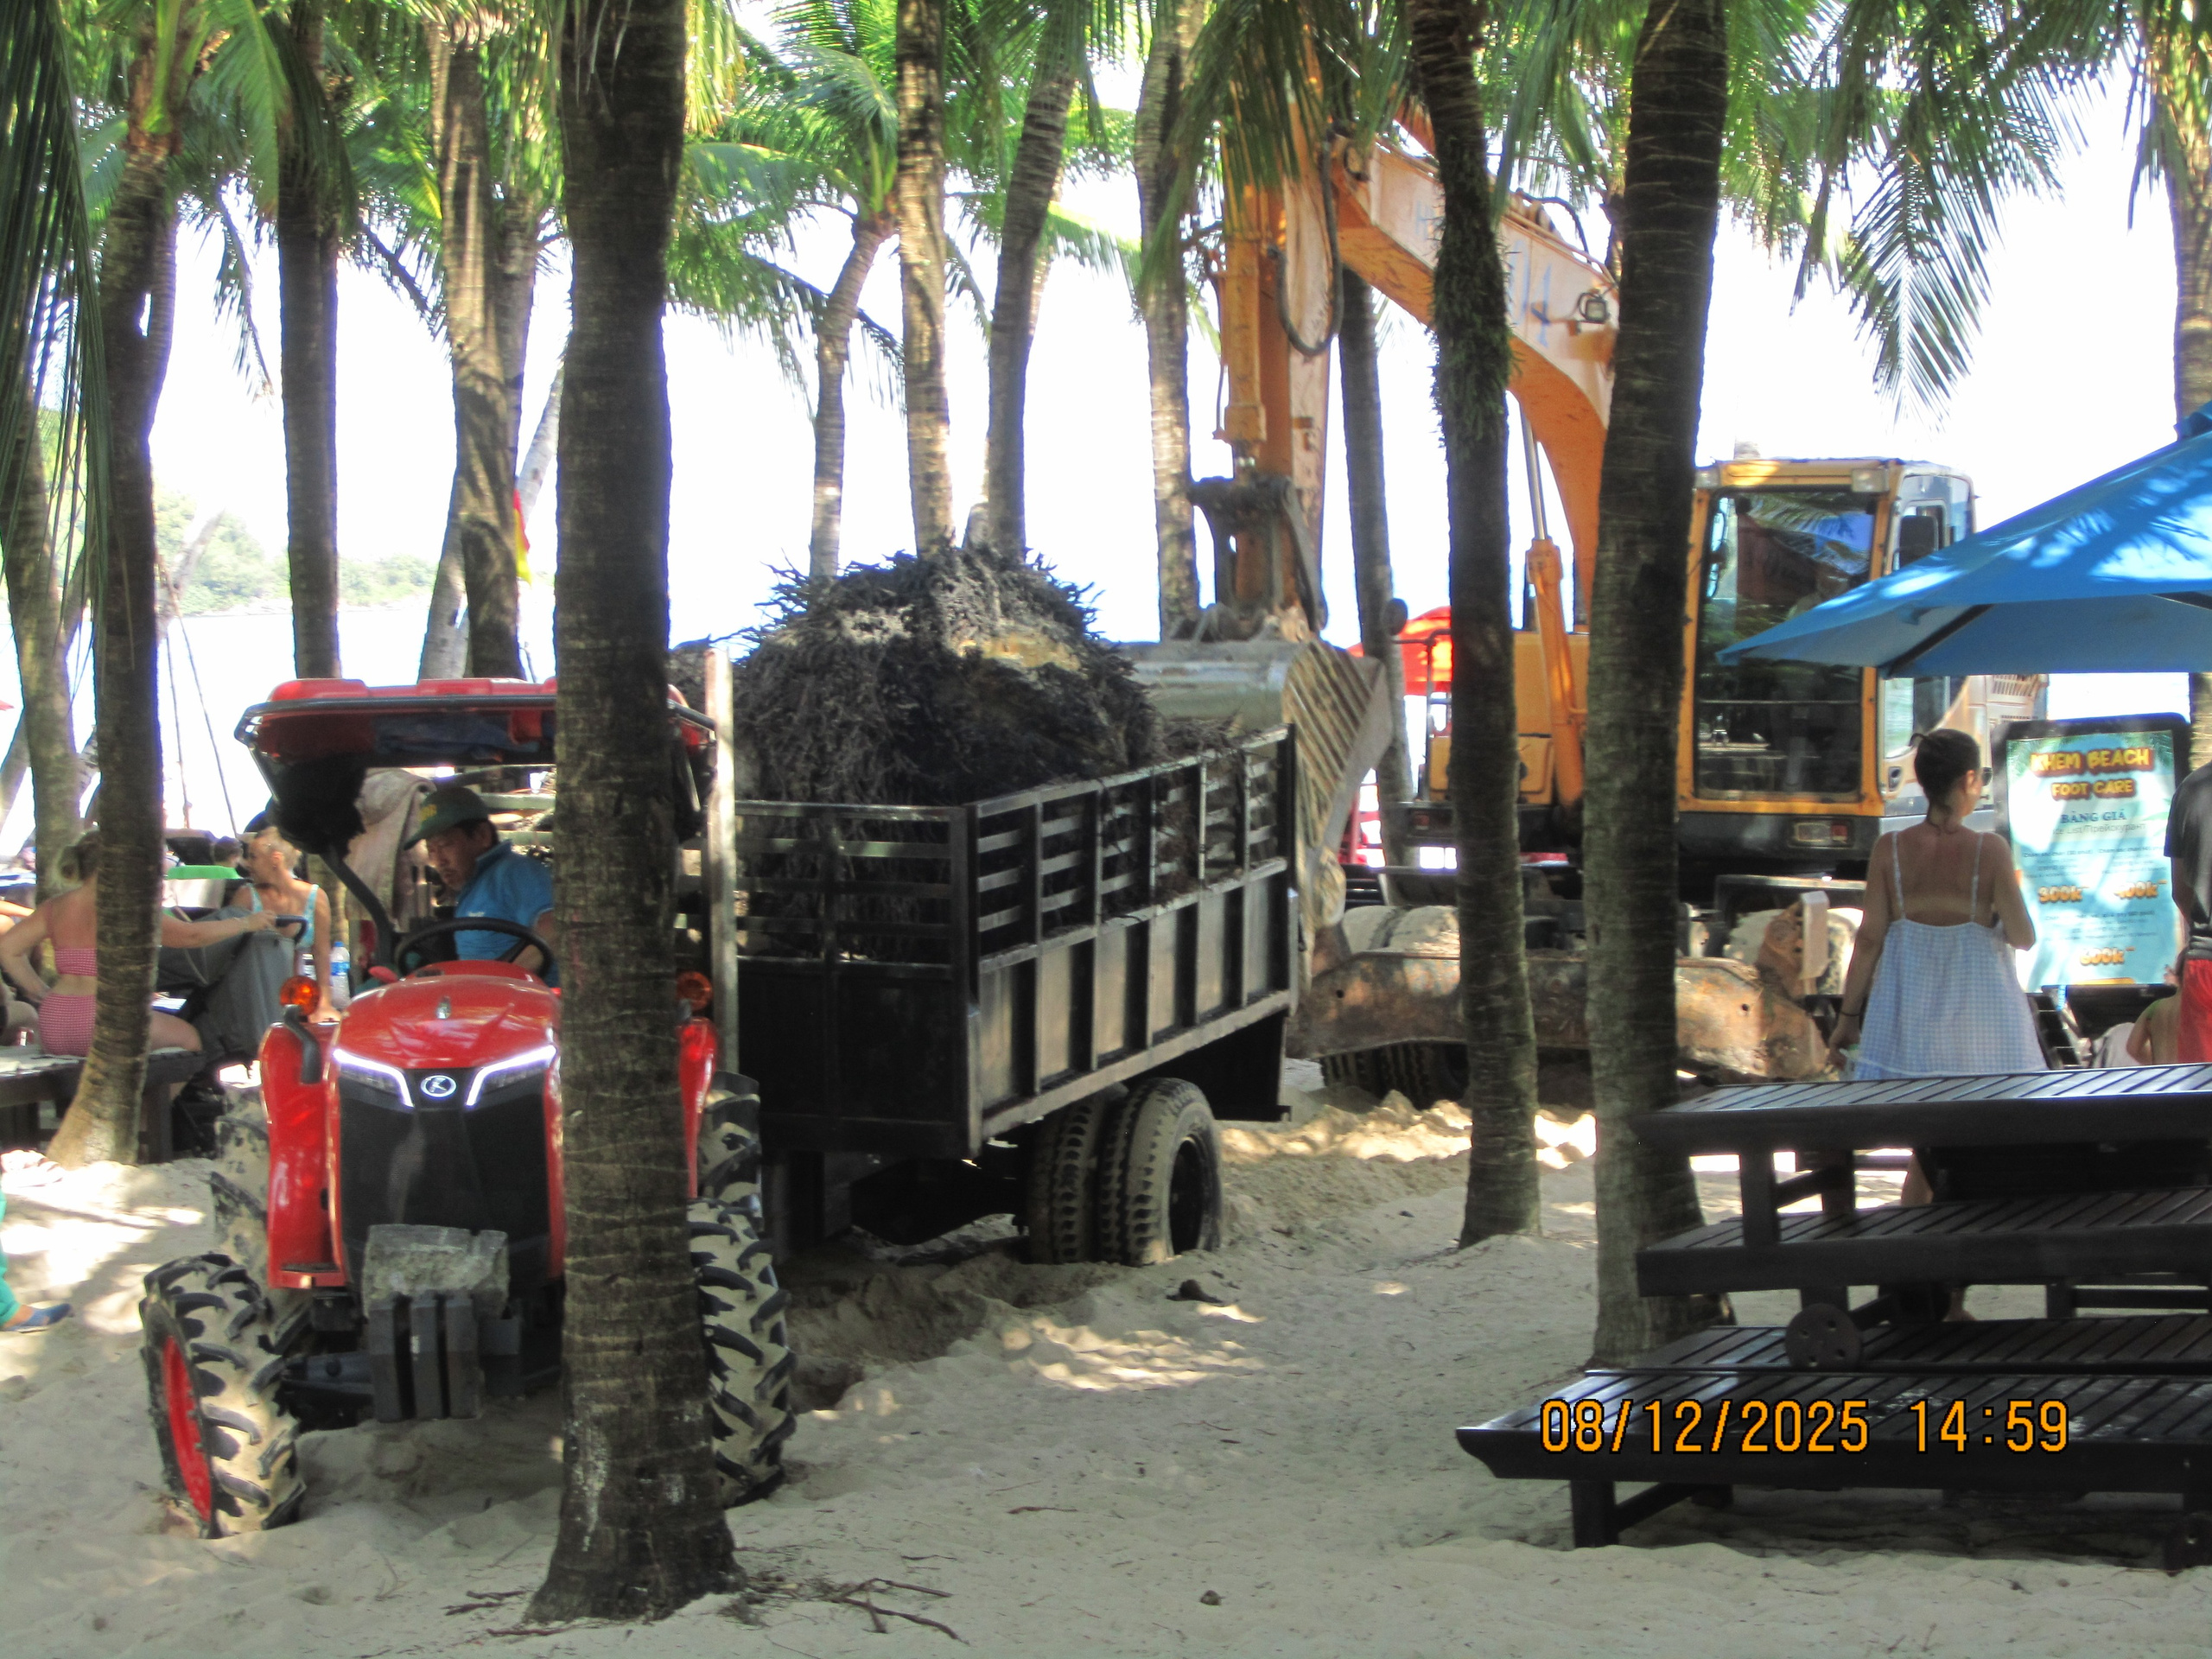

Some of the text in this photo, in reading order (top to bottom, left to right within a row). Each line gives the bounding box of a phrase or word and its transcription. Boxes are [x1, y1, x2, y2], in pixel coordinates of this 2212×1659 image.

[2029, 747, 2151, 772] KHEM BEACH
[2051, 779, 2134, 797] FOOT CARE
[2102, 808, 2127, 821] GIÁ
[2037, 885, 2083, 904] 300k
